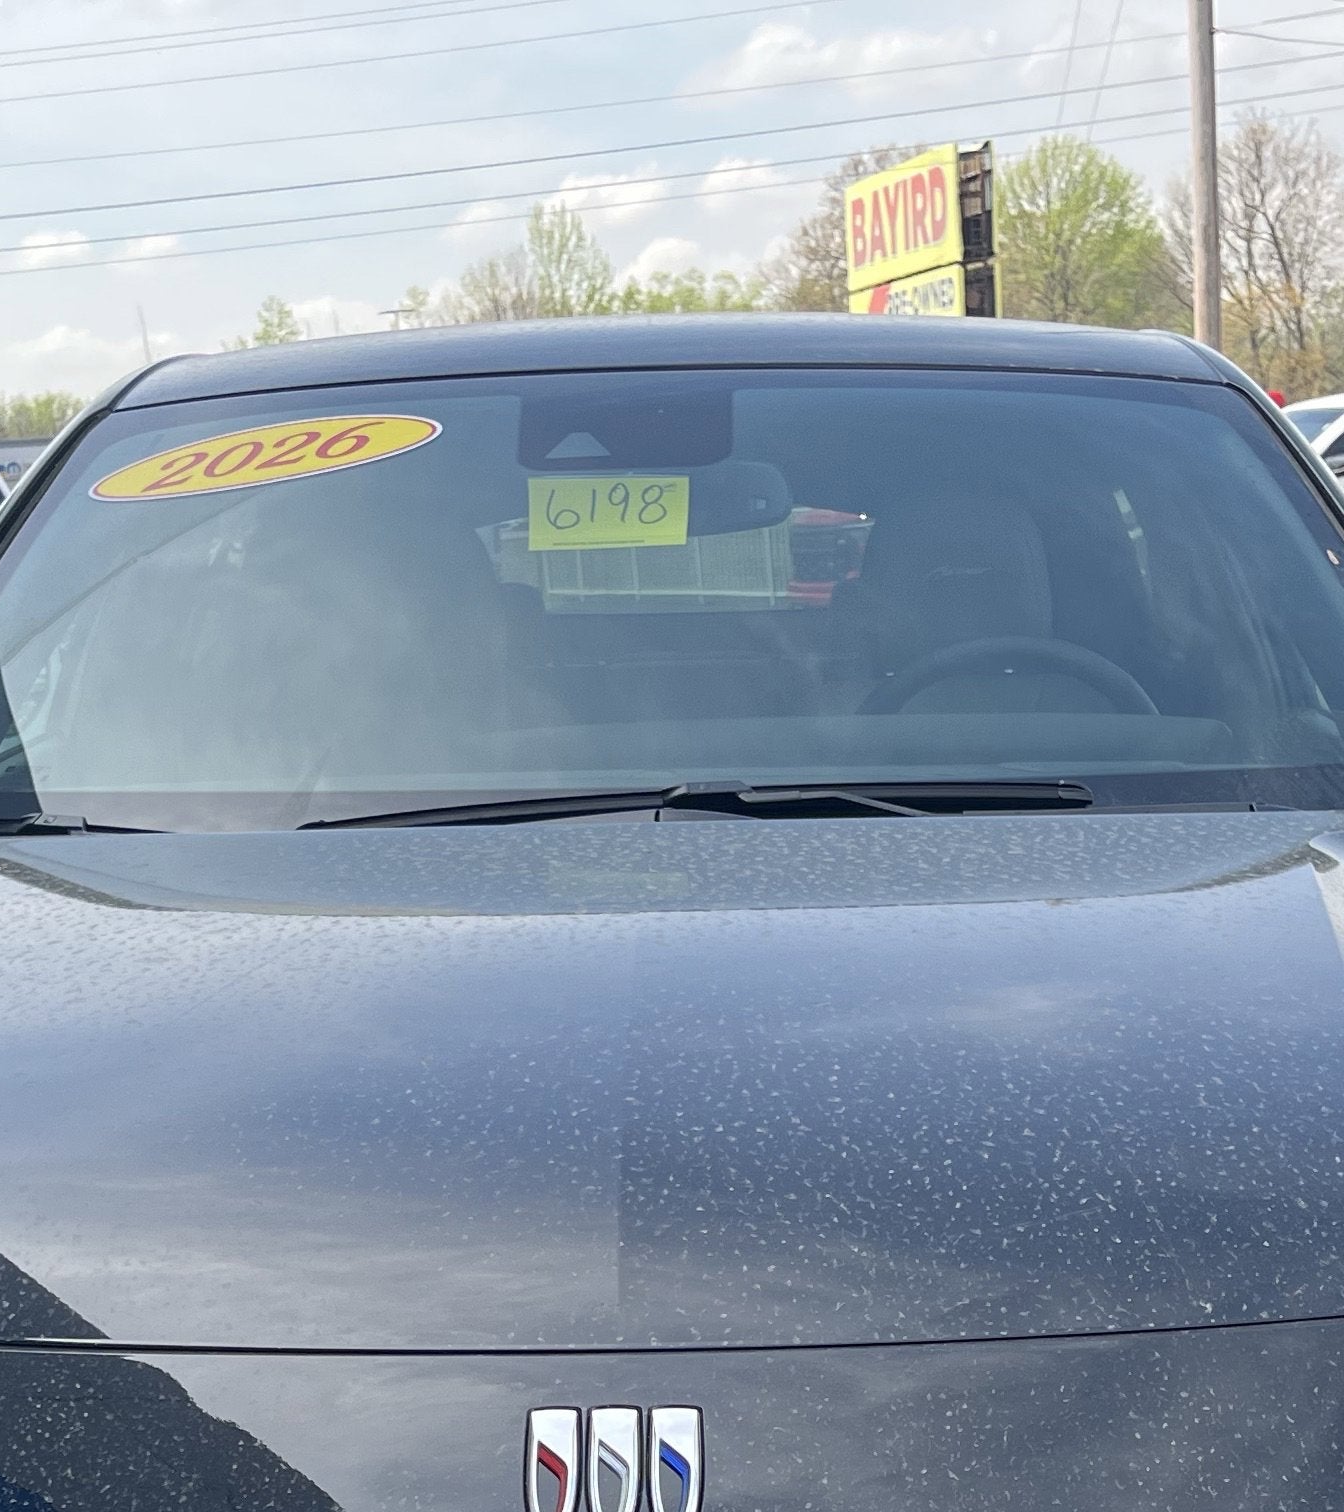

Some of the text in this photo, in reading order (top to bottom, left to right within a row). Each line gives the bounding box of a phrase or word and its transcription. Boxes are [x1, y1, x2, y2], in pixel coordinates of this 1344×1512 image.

[852, 173, 947, 269] BAYIRD
[140, 421, 386, 493] 2026
[546, 482, 668, 530] 6198
